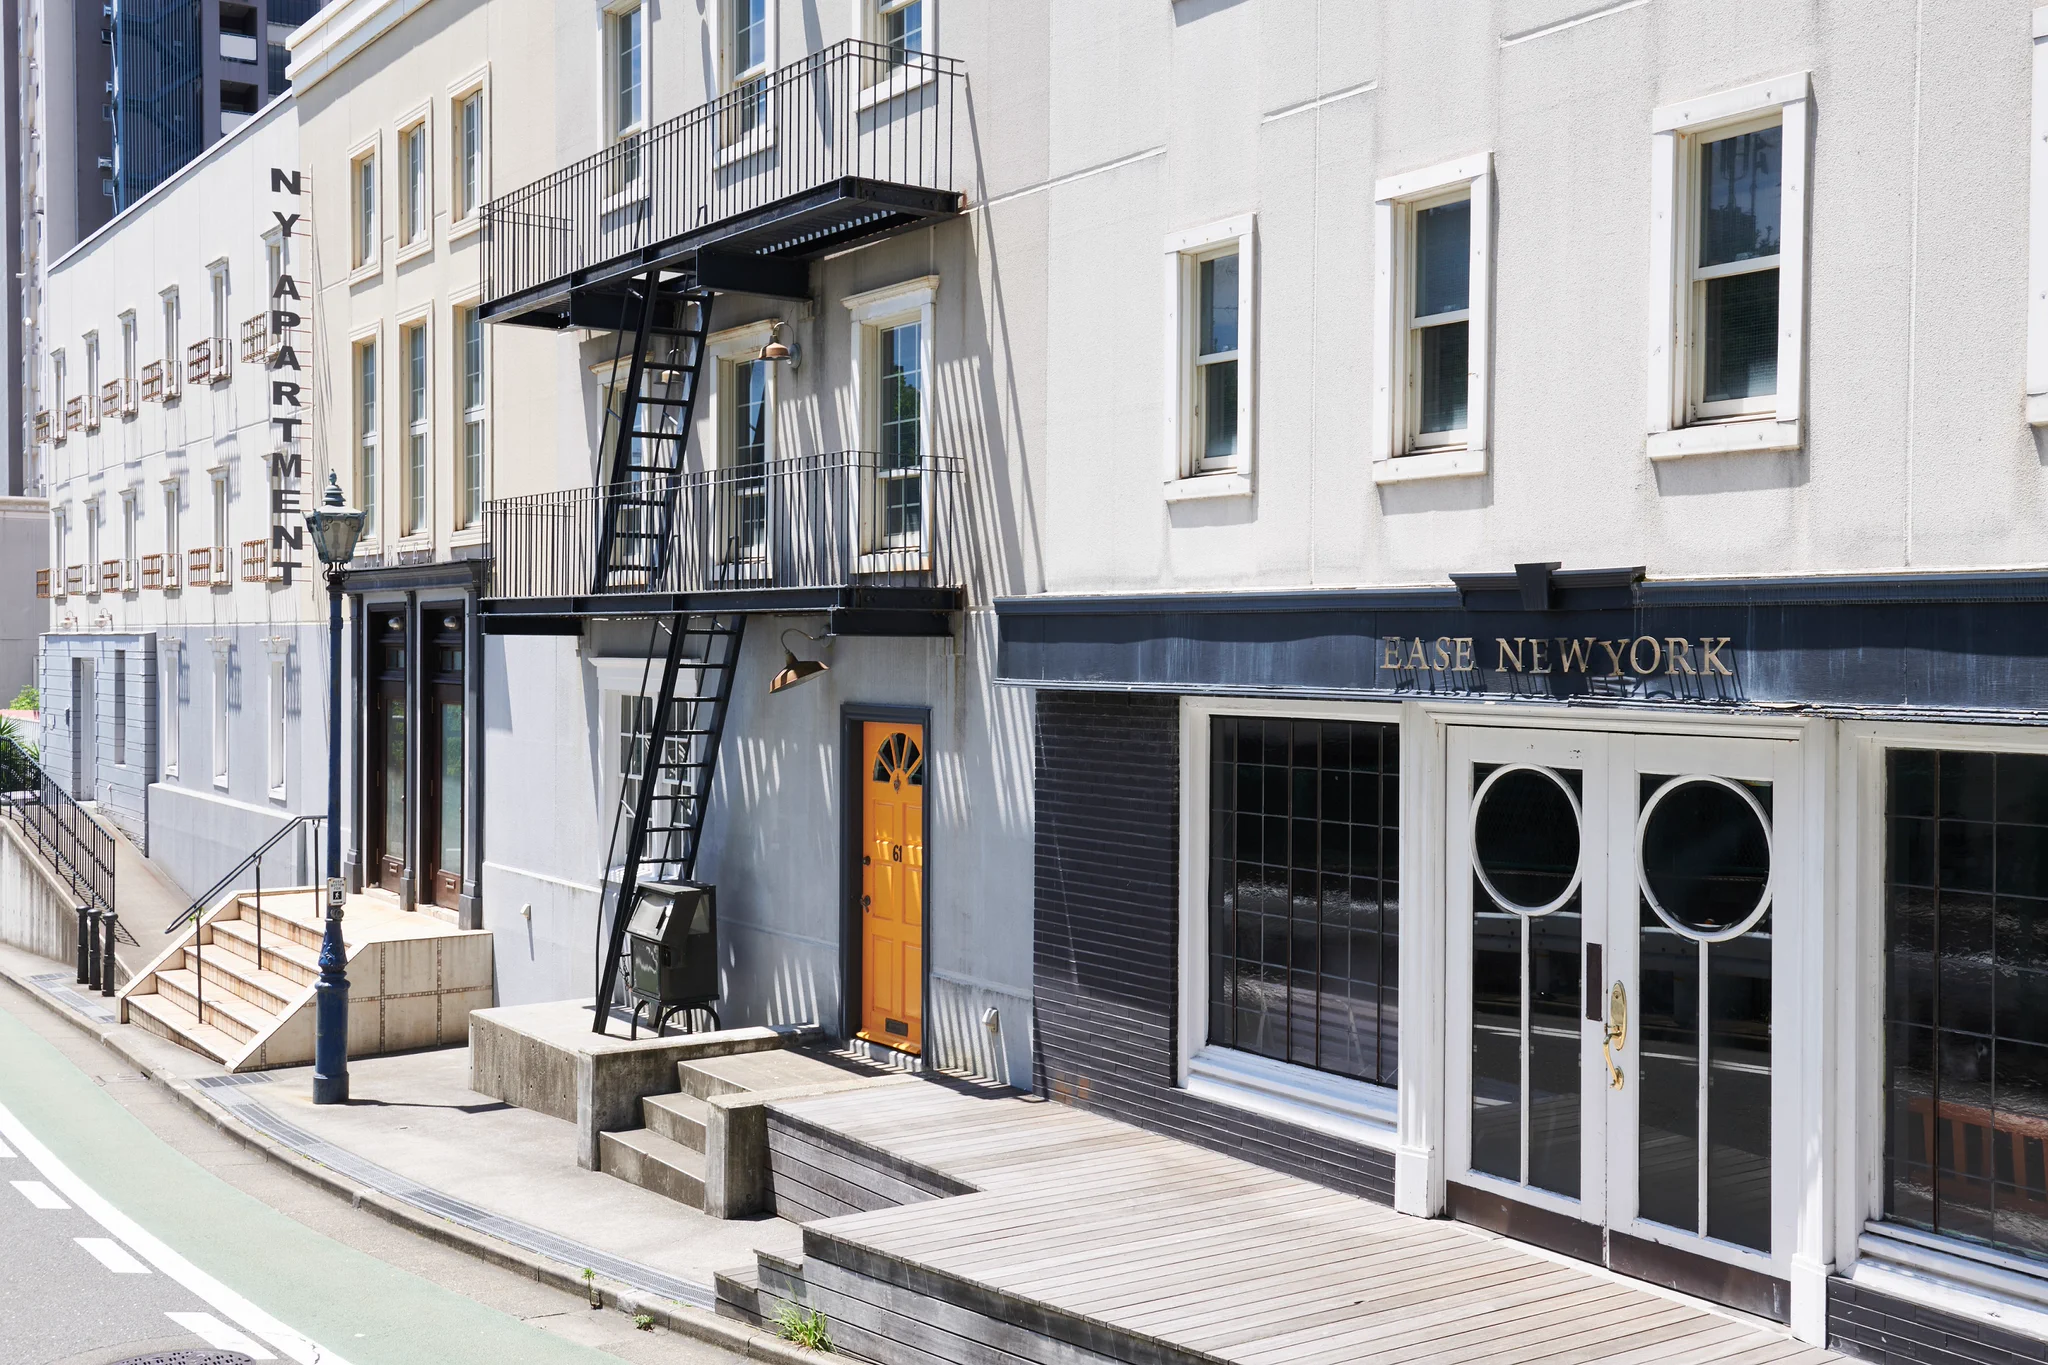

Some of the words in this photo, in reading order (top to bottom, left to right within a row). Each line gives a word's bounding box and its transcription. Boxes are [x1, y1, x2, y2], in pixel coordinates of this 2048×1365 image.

[271, 168, 301, 238] NY
[272, 274, 302, 586] APARTMENT
[1380, 636, 1475, 672] EASE
[892, 844, 903, 863] 61
